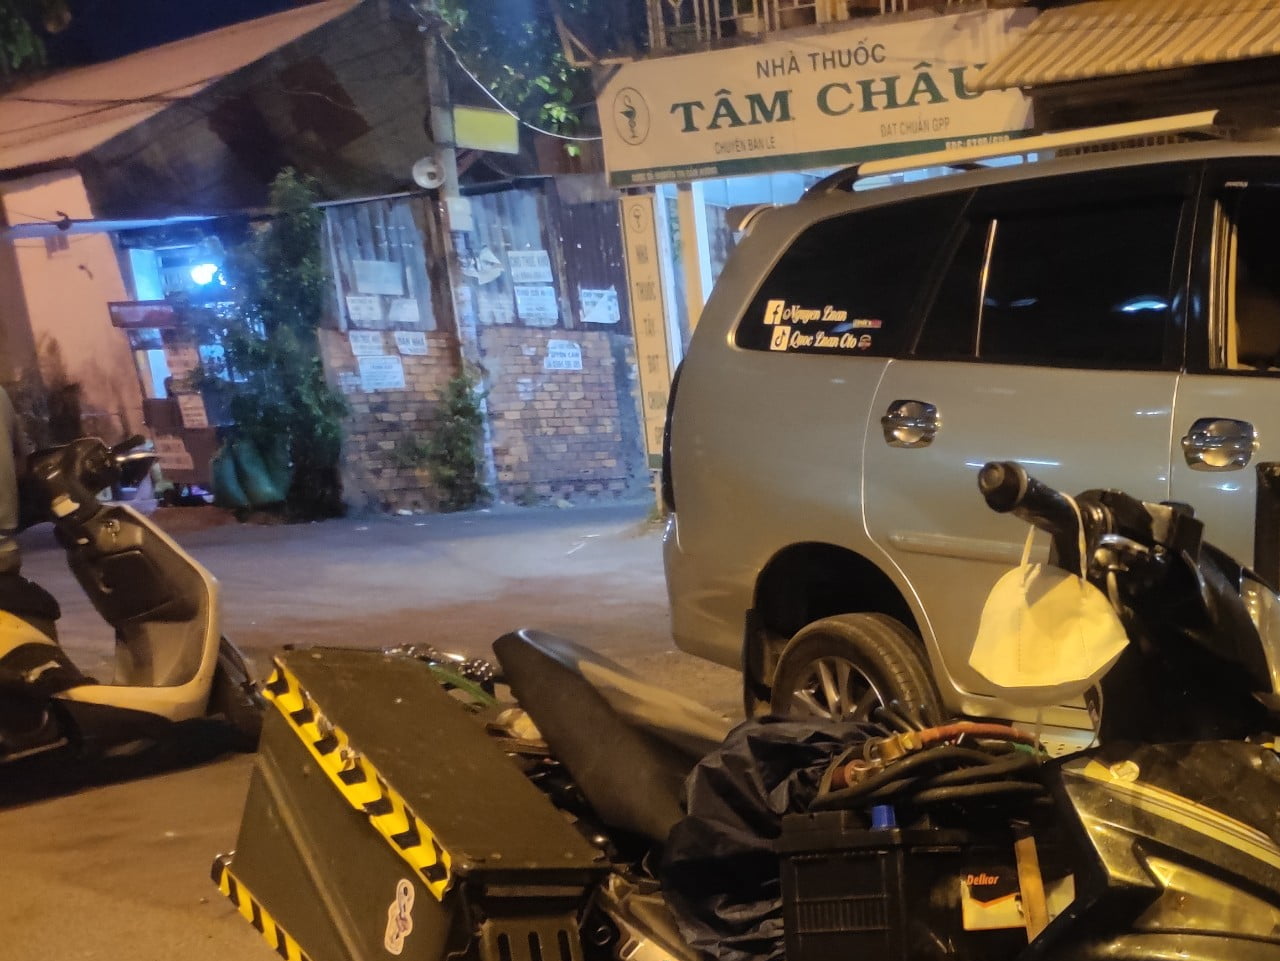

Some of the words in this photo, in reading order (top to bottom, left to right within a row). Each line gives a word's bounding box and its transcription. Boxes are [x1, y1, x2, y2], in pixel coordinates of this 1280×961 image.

[756, 50, 800, 79] NHÀ
[807, 37, 886, 72] THUỐC
[670, 88, 792, 133] TÂM
[816, 61, 988, 117] CHÂU
